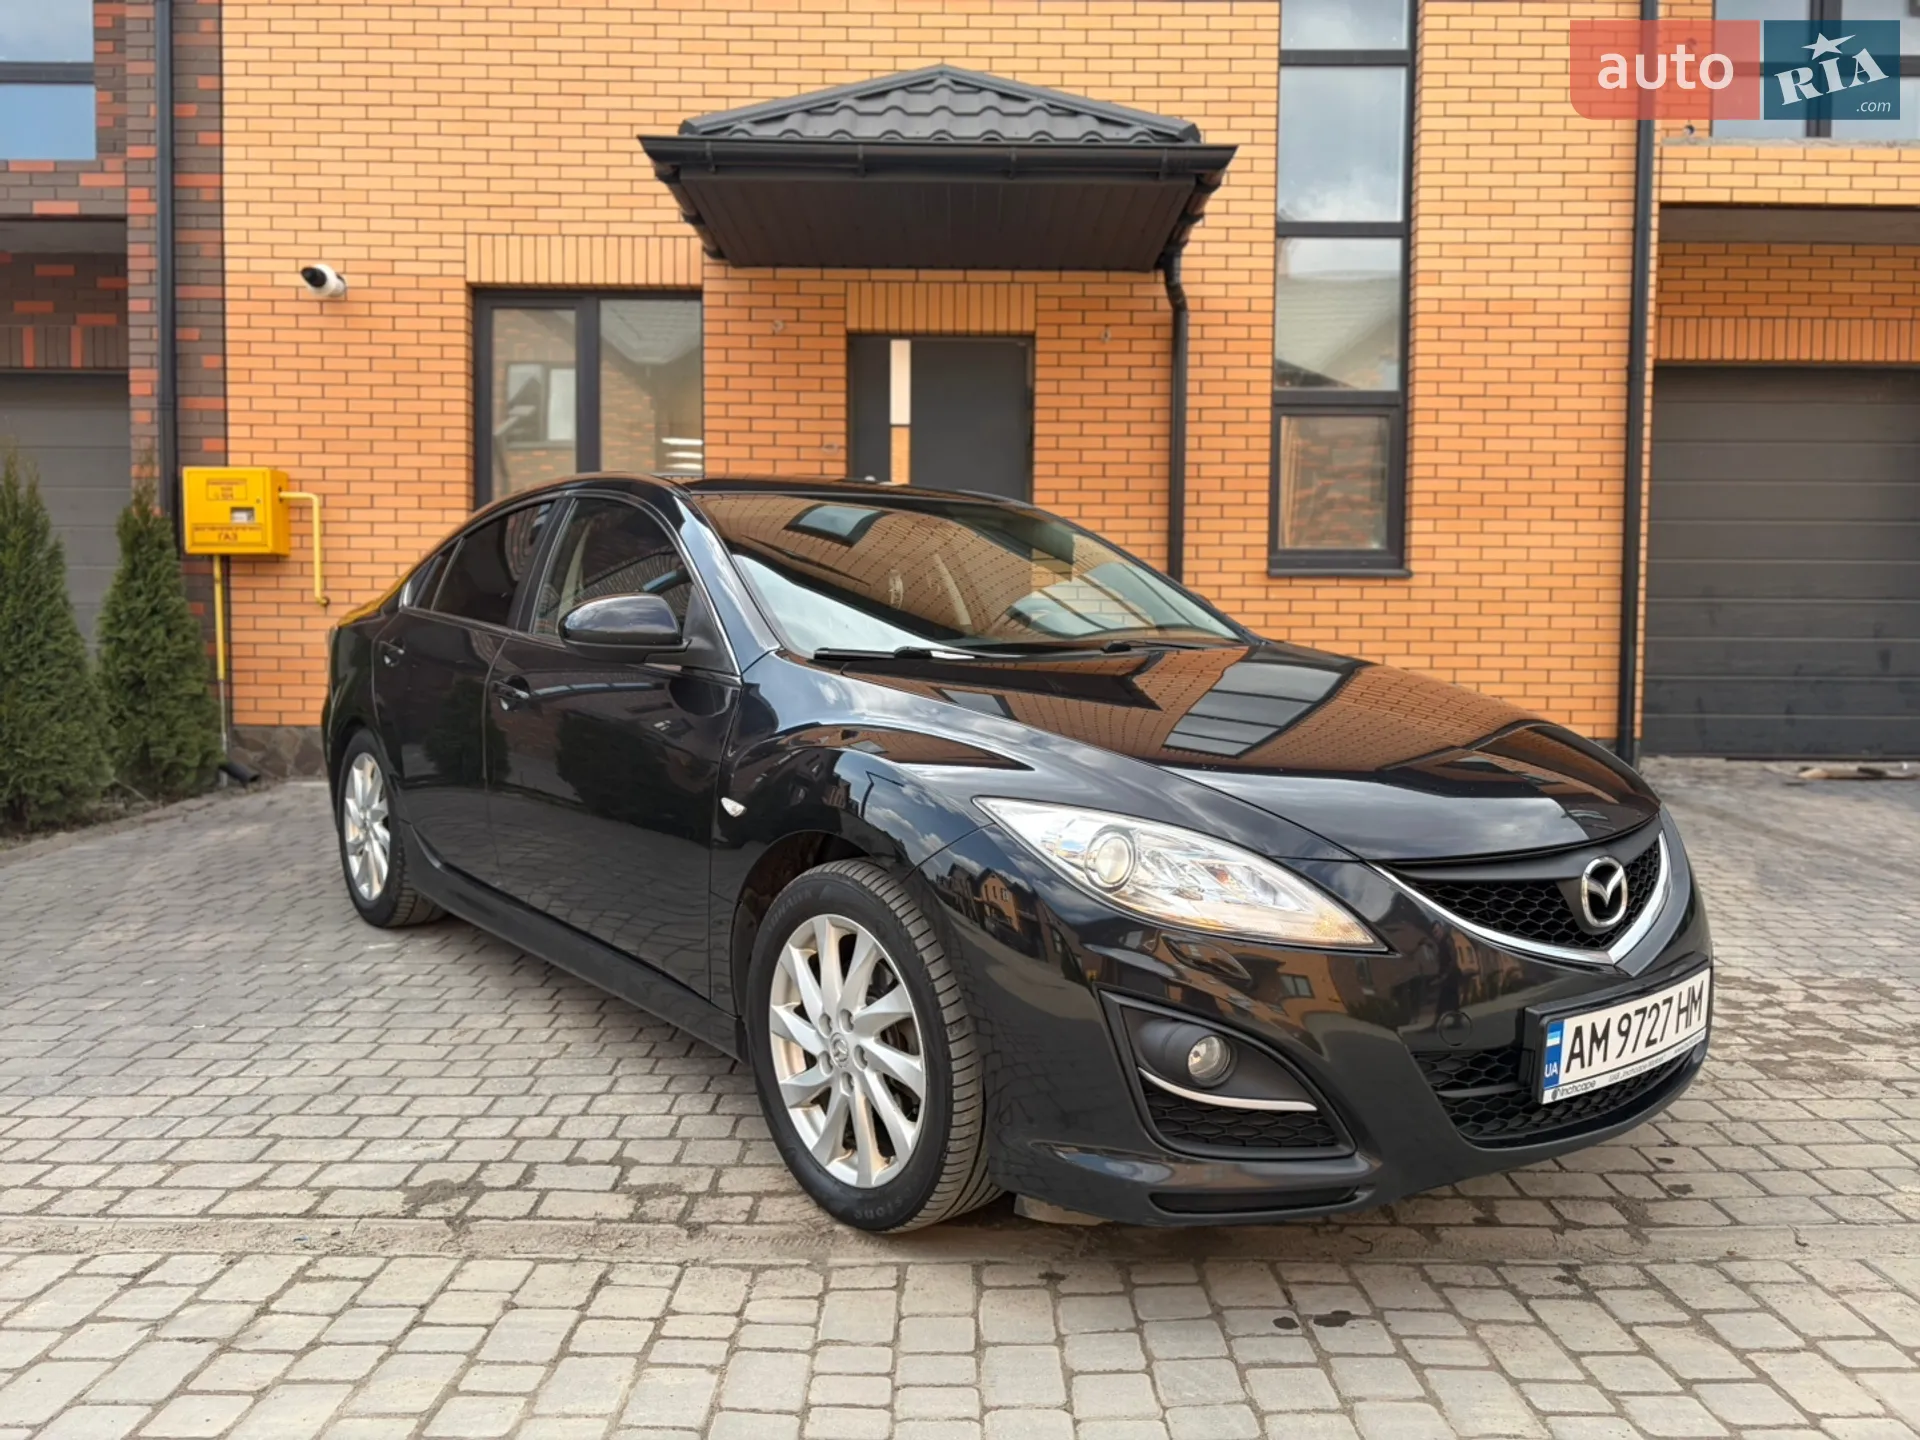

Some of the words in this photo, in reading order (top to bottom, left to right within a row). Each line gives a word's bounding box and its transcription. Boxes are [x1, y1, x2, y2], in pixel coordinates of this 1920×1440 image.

[1565, 1017, 1611, 1073] AM
[1615, 995, 1673, 1060] 9727
[1674, 979, 1704, 1034] HM
[1544, 1061, 1559, 1078] UA
